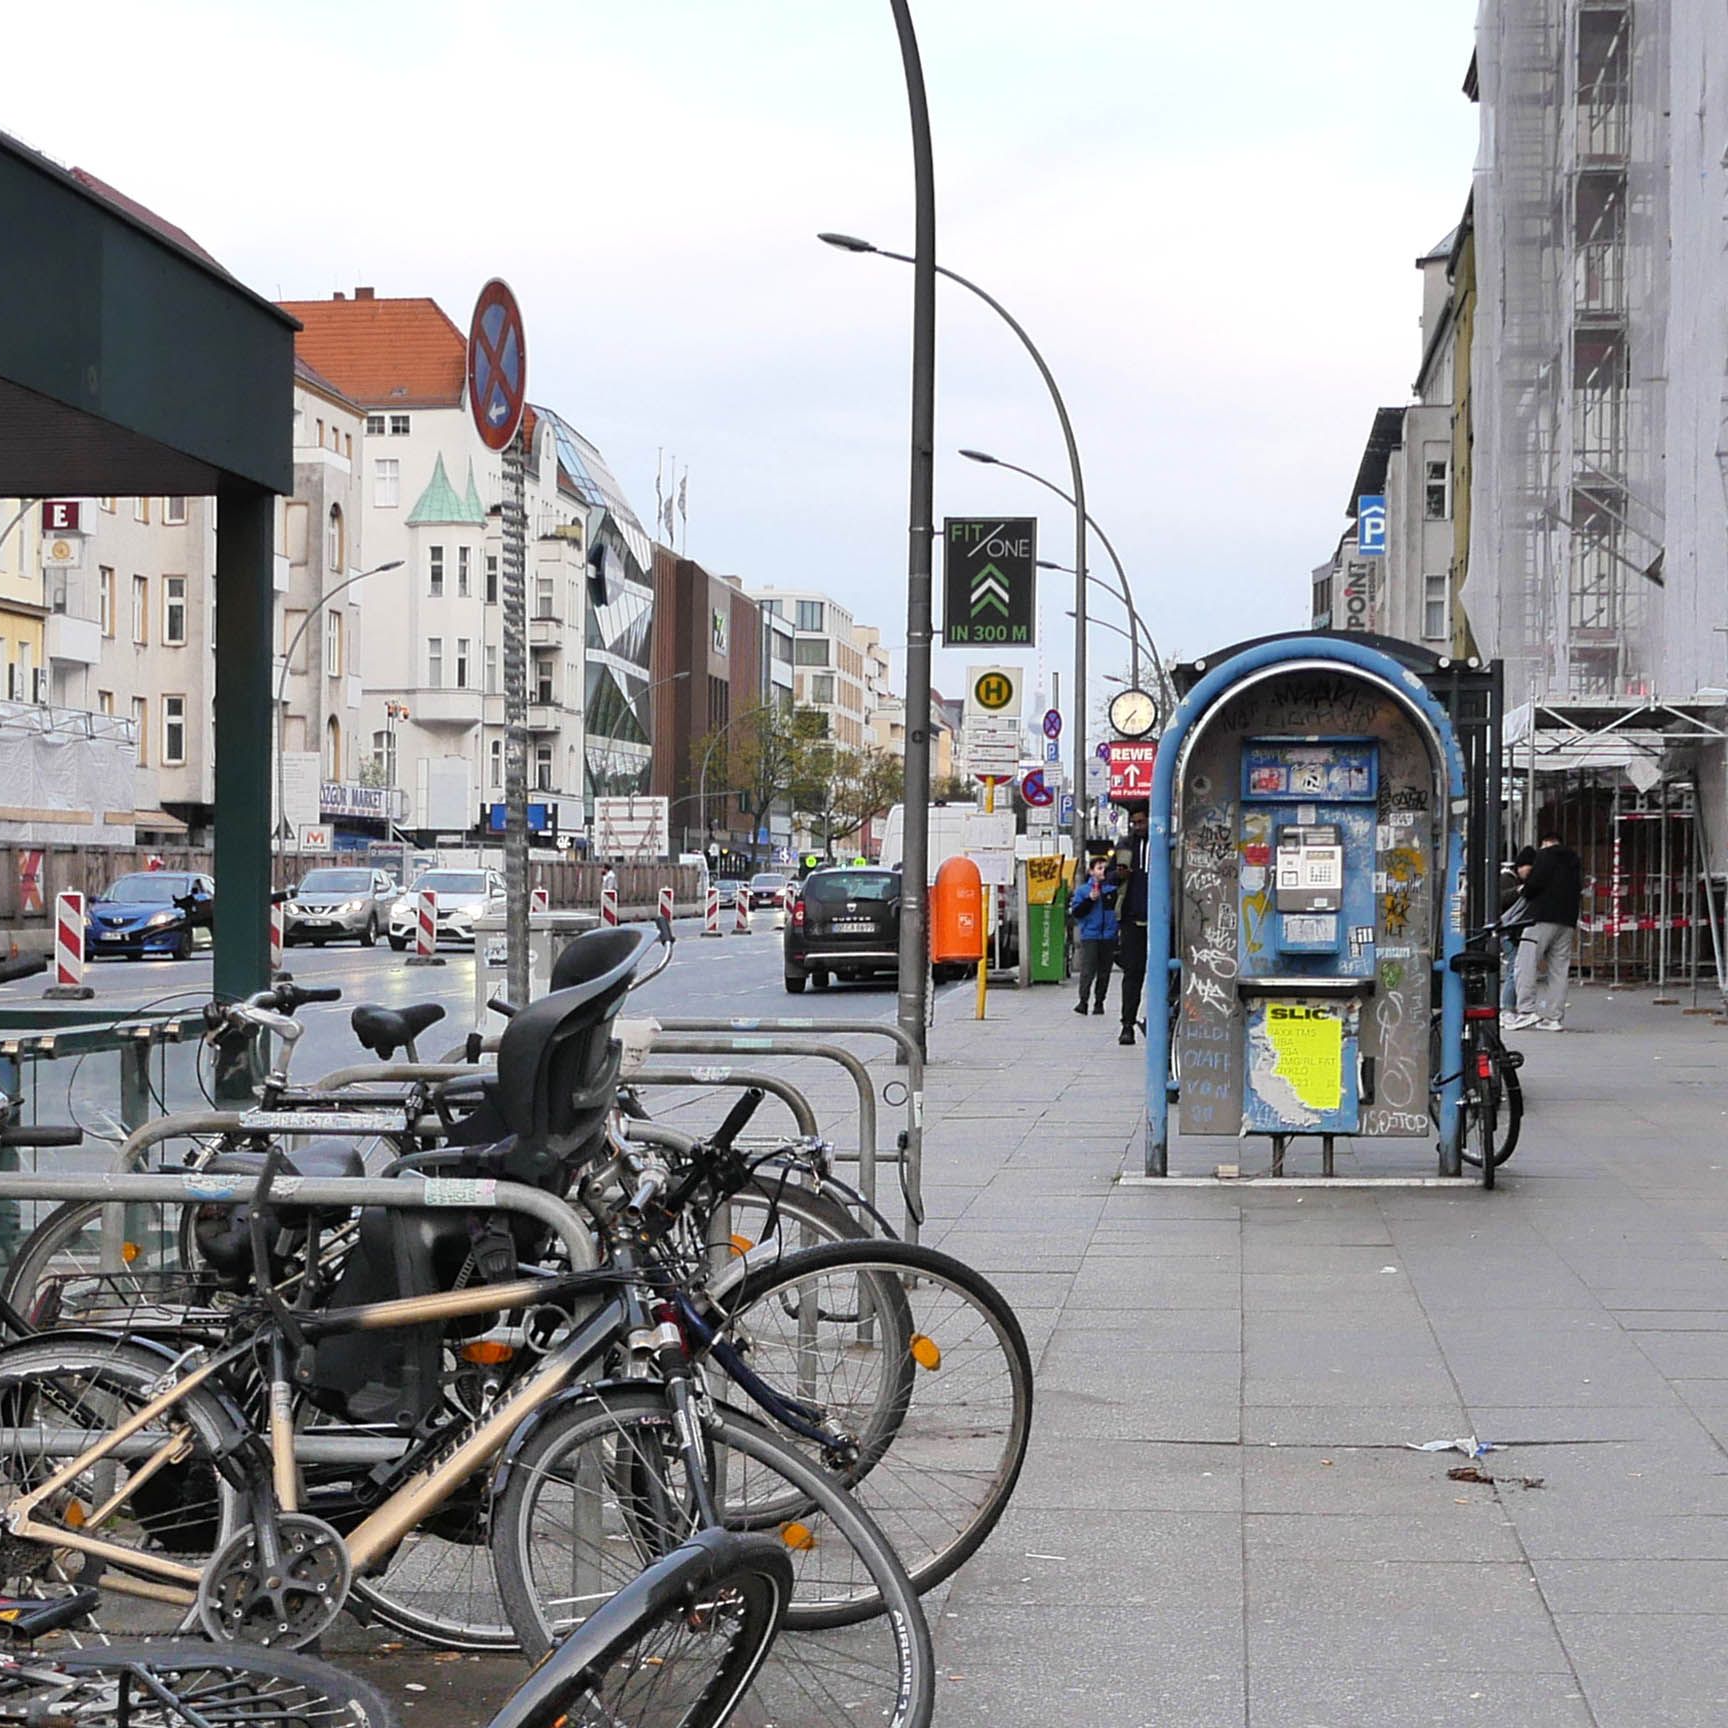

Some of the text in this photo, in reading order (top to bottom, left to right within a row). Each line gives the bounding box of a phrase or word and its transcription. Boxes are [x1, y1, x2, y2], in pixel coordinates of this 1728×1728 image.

[52, 504, 69, 527] E
[951, 523, 984, 542] FIT
[1364, 517, 1385, 544] P
[986, 539, 1030, 558] ONE
[1344, 561, 1367, 629] POINT
[951, 625, 1028, 641] IN 300 M
[985, 681, 1003, 701] H
[1110, 747, 1153, 762] REWE
[352, 787, 383, 809] MARKET
